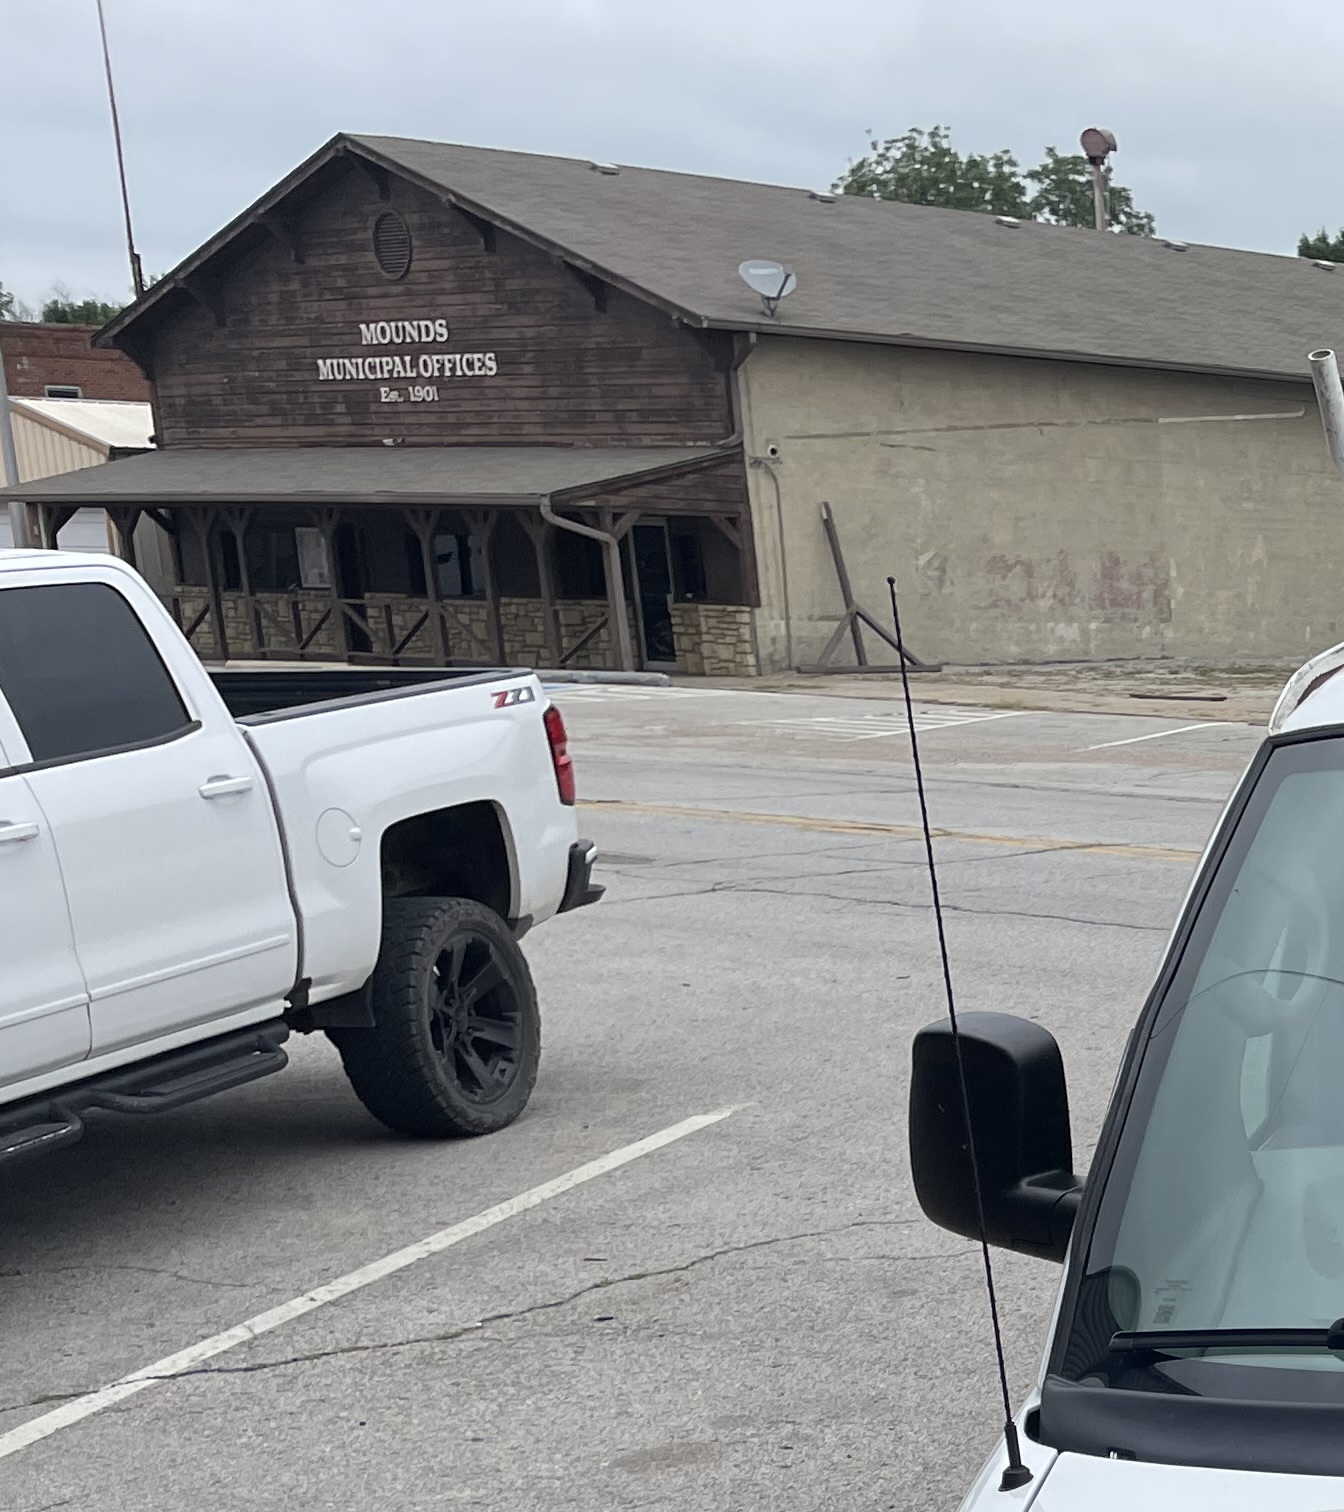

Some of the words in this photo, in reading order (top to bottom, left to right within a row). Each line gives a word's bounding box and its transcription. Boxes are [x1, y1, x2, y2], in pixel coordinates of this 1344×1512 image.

[359, 319, 449, 345] MOUNDS
[317, 356, 417, 380] MUNICIPAL
[418, 352, 498, 378] OFFICES
[408, 385, 439, 402] 1901
[490, 686, 536, 709] Z71
